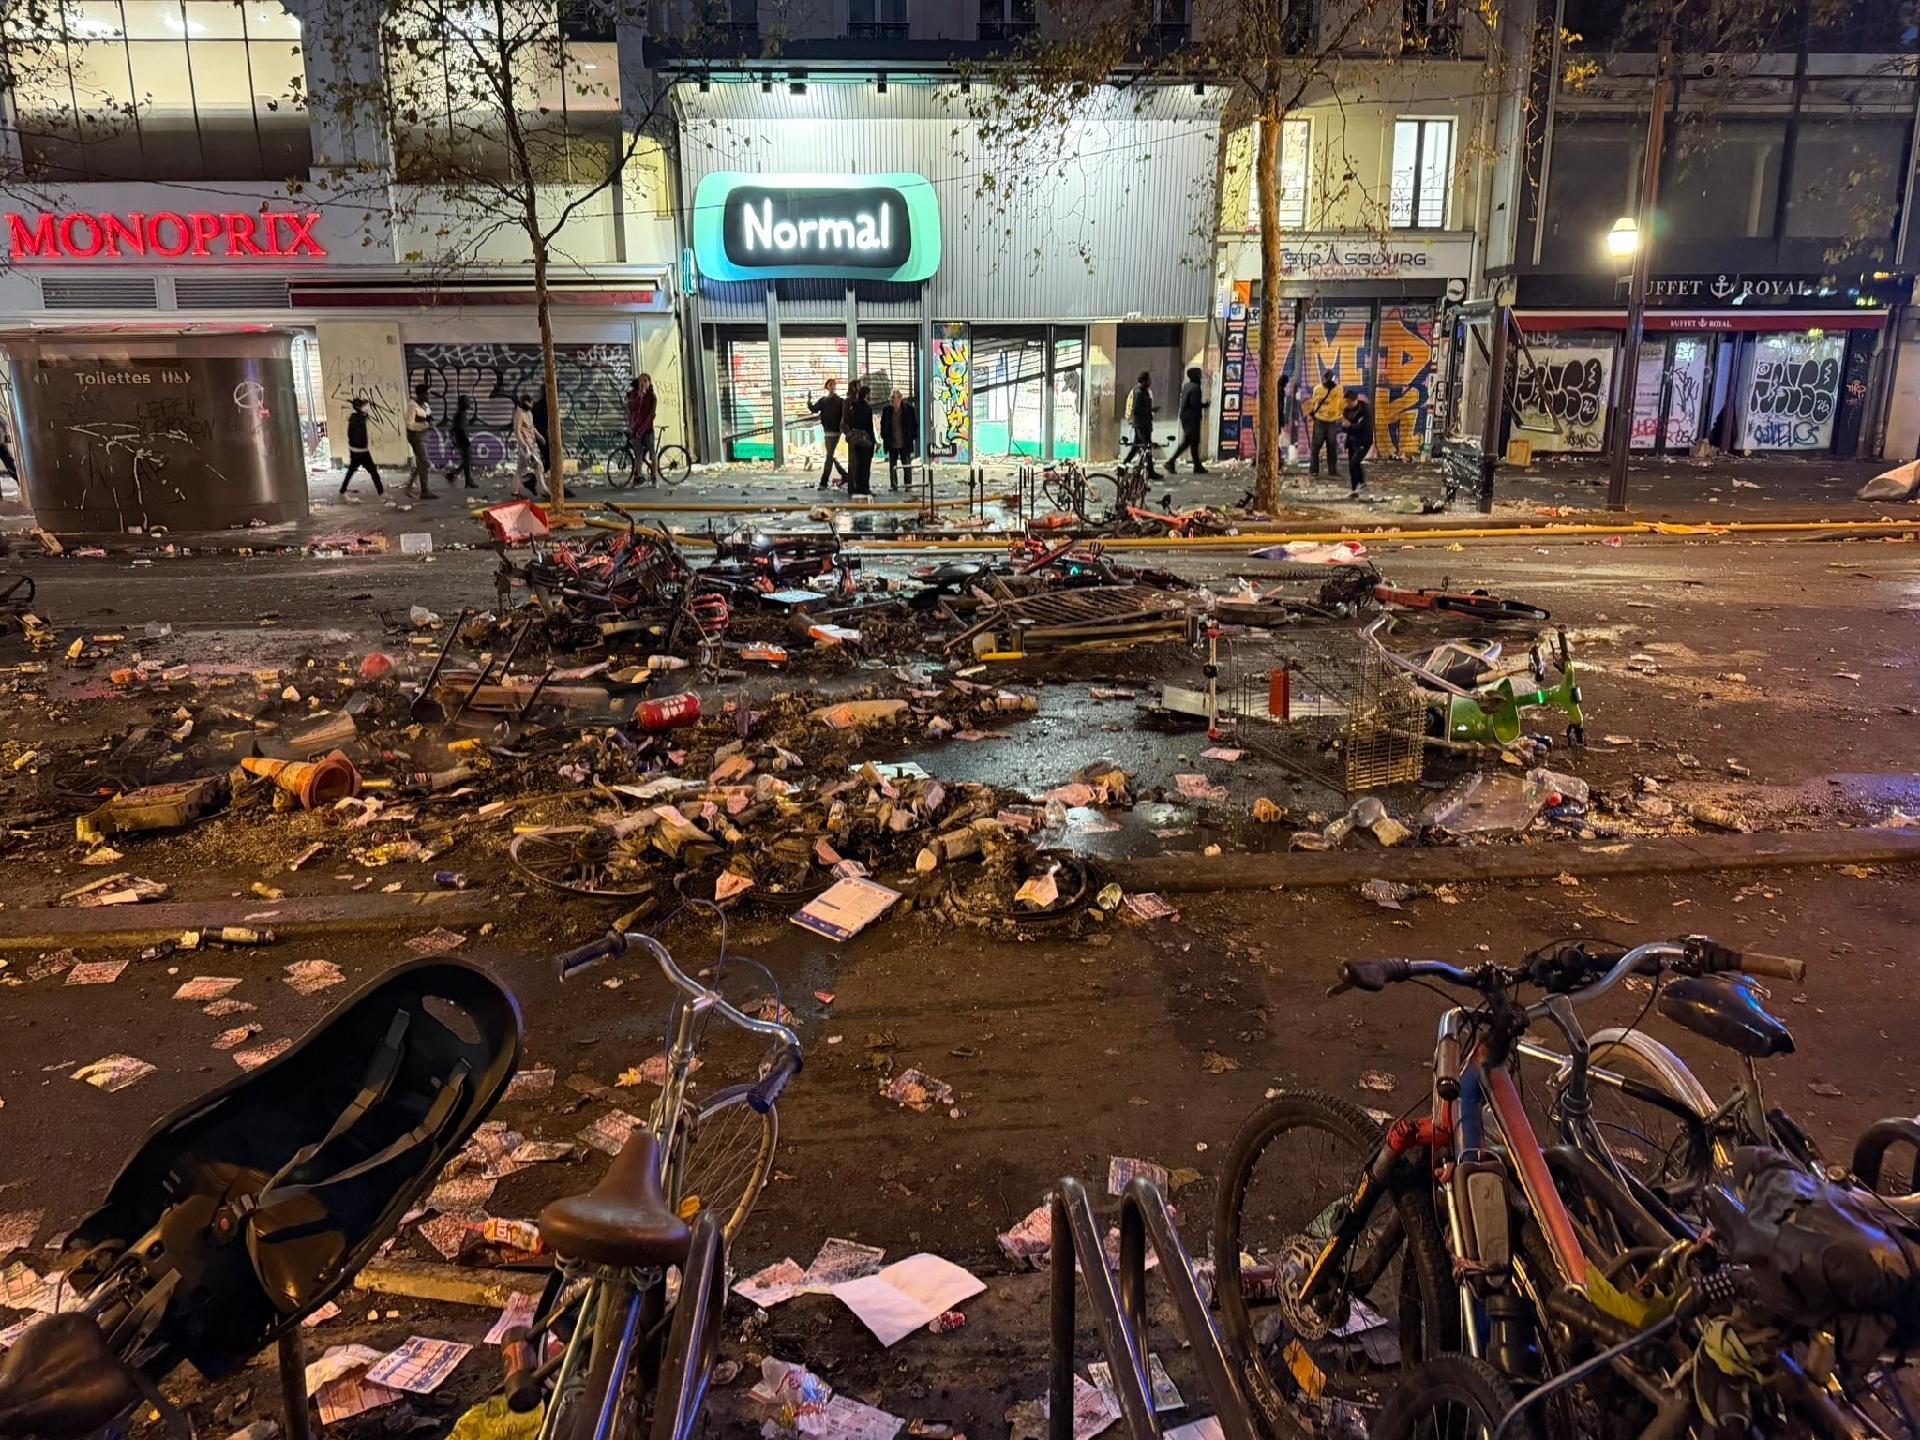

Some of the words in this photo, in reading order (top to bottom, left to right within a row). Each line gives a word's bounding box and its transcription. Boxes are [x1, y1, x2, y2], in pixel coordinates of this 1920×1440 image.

[5, 211, 327, 257] MONOPRIX
[744, 198, 890, 250] Normal
[1285, 244, 1426, 267] STRASBOURG
[1742, 280, 1808, 296] ROYAL
[1709, 319, 1732, 328] ROYAL
[74, 371, 152, 385] Toilettes
[1243, 1360, 1277, 1422] PYTHON
